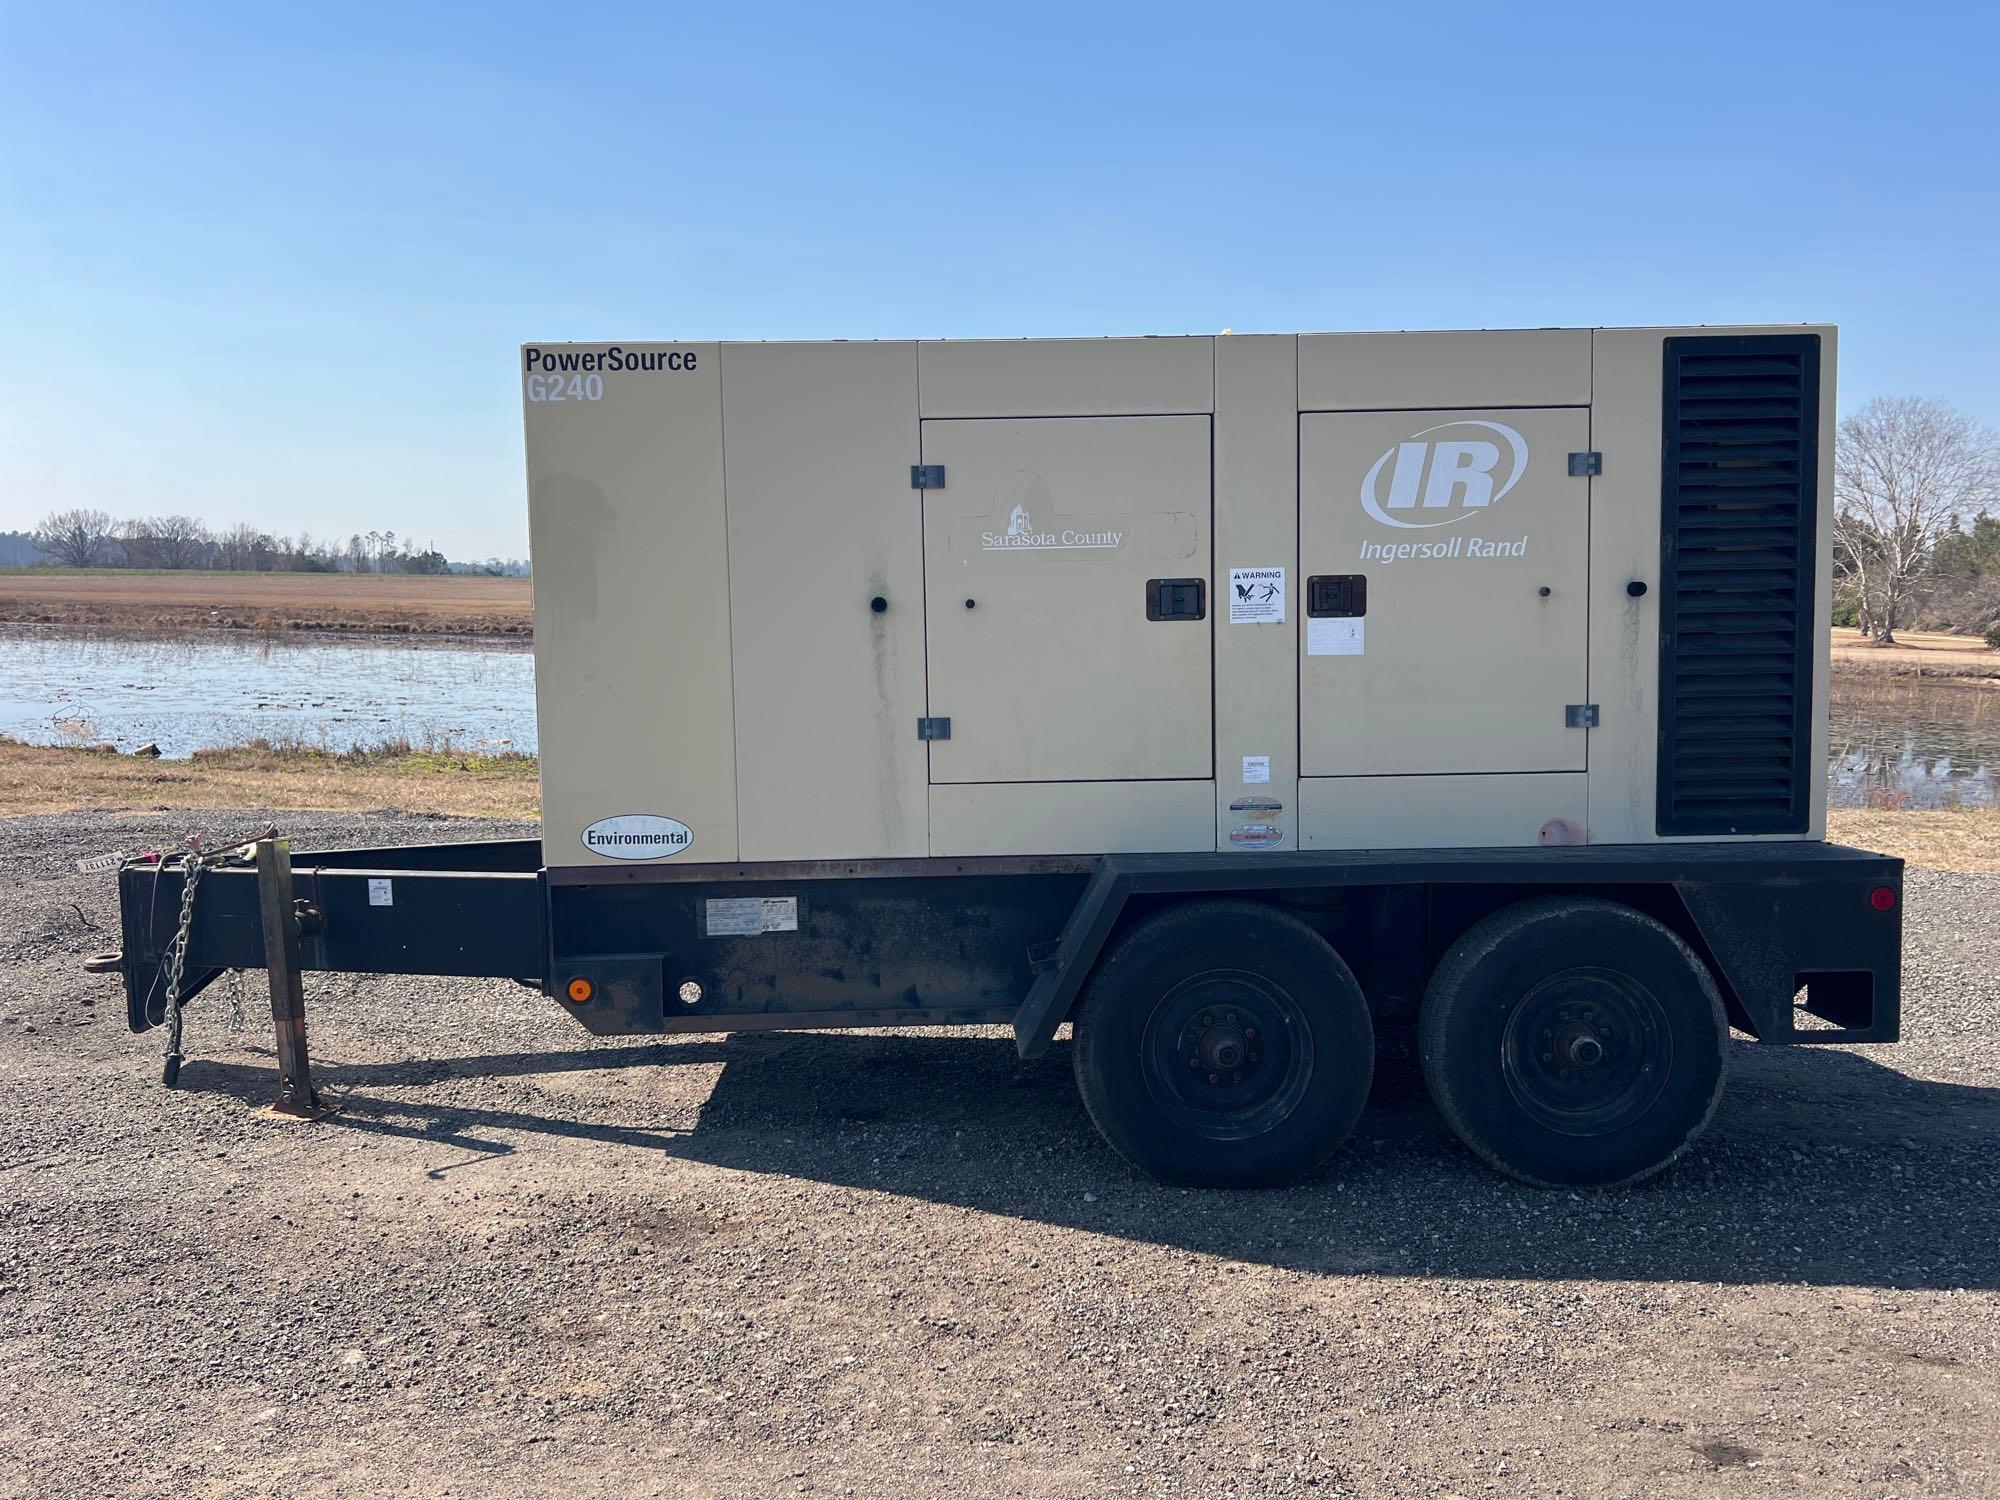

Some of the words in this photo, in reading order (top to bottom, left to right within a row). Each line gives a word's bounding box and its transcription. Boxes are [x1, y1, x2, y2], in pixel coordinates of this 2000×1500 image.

[526, 347, 697, 372] PowerSource
[527, 374, 604, 402] G240
[1387, 441, 1500, 508] IR
[982, 531, 1056, 547] Sarasota
[1062, 530, 1122, 547] County
[1359, 537, 1462, 564] Ingersoll
[1467, 536, 1528, 557] Rand
[1242, 571, 1281, 579] WARNING
[587, 830, 688, 845] Environmental
